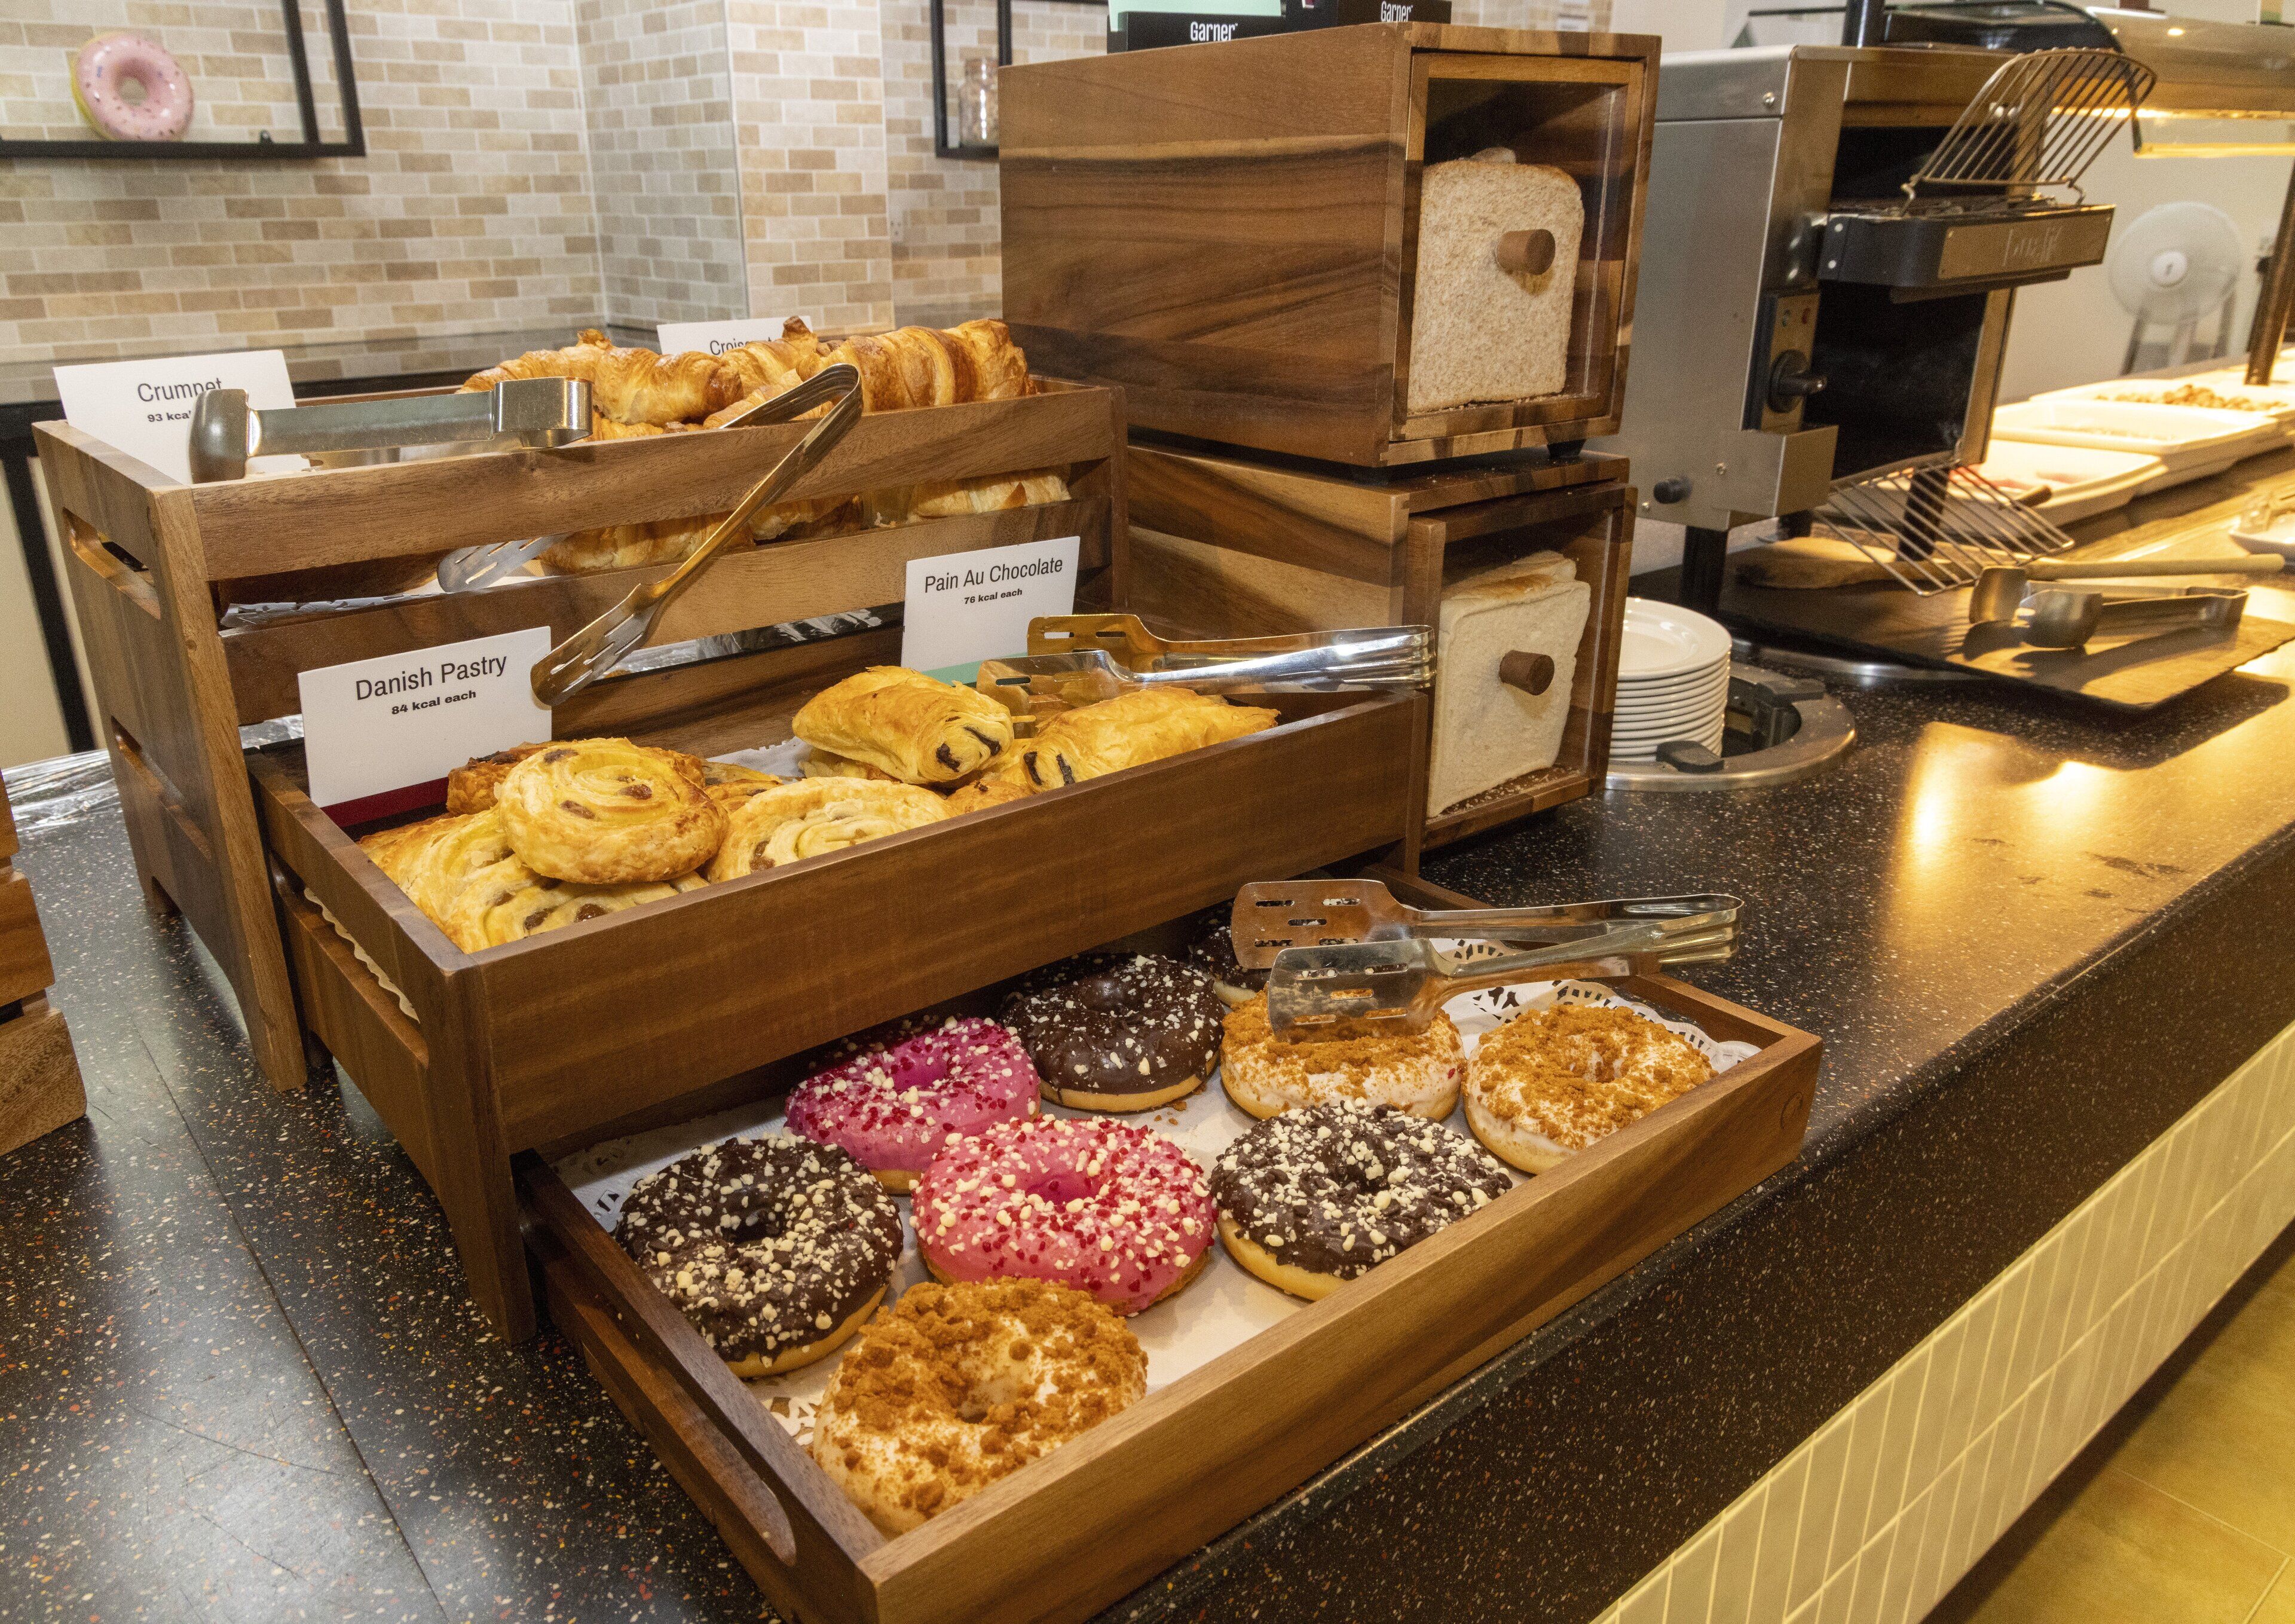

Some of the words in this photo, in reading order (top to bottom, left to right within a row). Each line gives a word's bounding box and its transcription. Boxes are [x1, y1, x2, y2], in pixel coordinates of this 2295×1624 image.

[147, 414, 163, 422] 93
[925, 573, 958, 593] Pain
[963, 570, 984, 586] Au
[990, 558, 1063, 582] Chocolate
[978, 592, 997, 602] kcal
[1000, 588, 1023, 598] each
[356, 667, 432, 700] Danish
[441, 656, 507, 683] Pastry
[391, 704, 408, 714] 84
[412, 696, 440, 711] kcal
[445, 690, 476, 704] each
